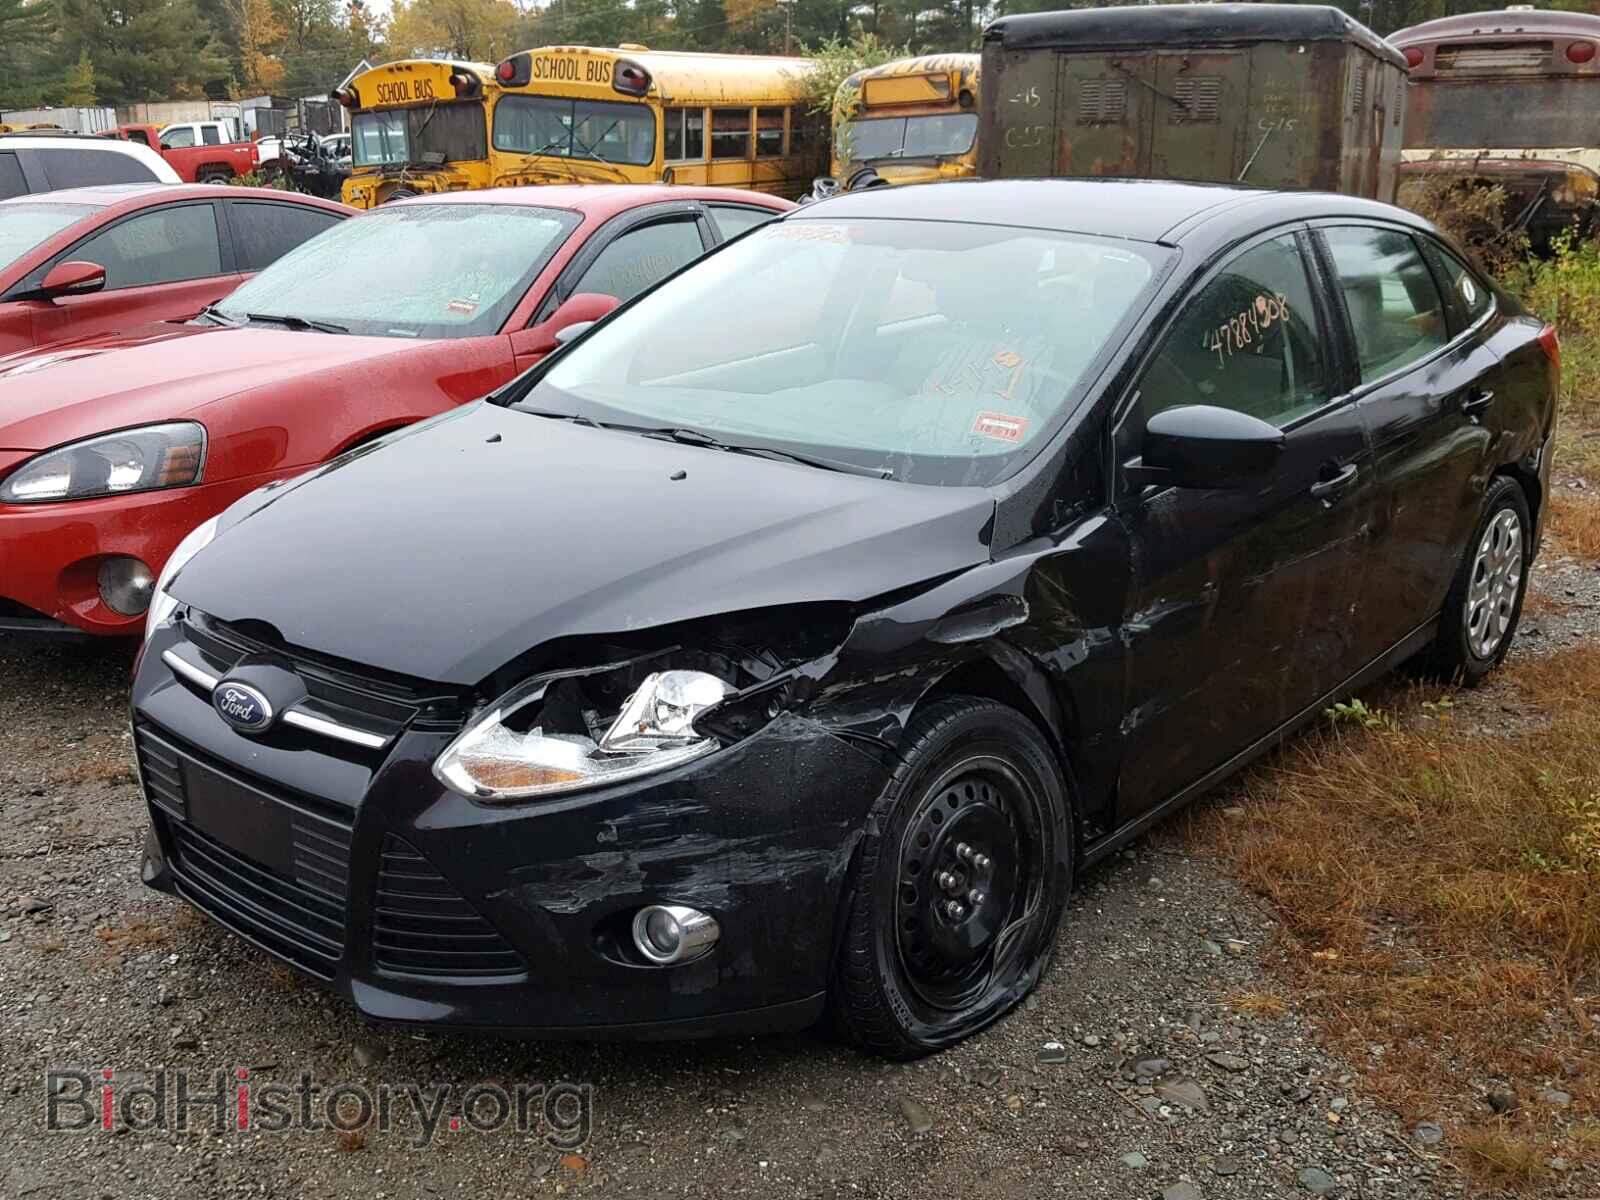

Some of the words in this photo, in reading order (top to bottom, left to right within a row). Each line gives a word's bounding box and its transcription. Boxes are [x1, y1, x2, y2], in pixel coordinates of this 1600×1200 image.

[534, 56, 581, 81] SCHOOL
[586, 60, 611, 82] BUS
[376, 80, 412, 103] SCHOOL
[414, 78, 433, 99] BUS
[220, 688, 256, 721] Ford
